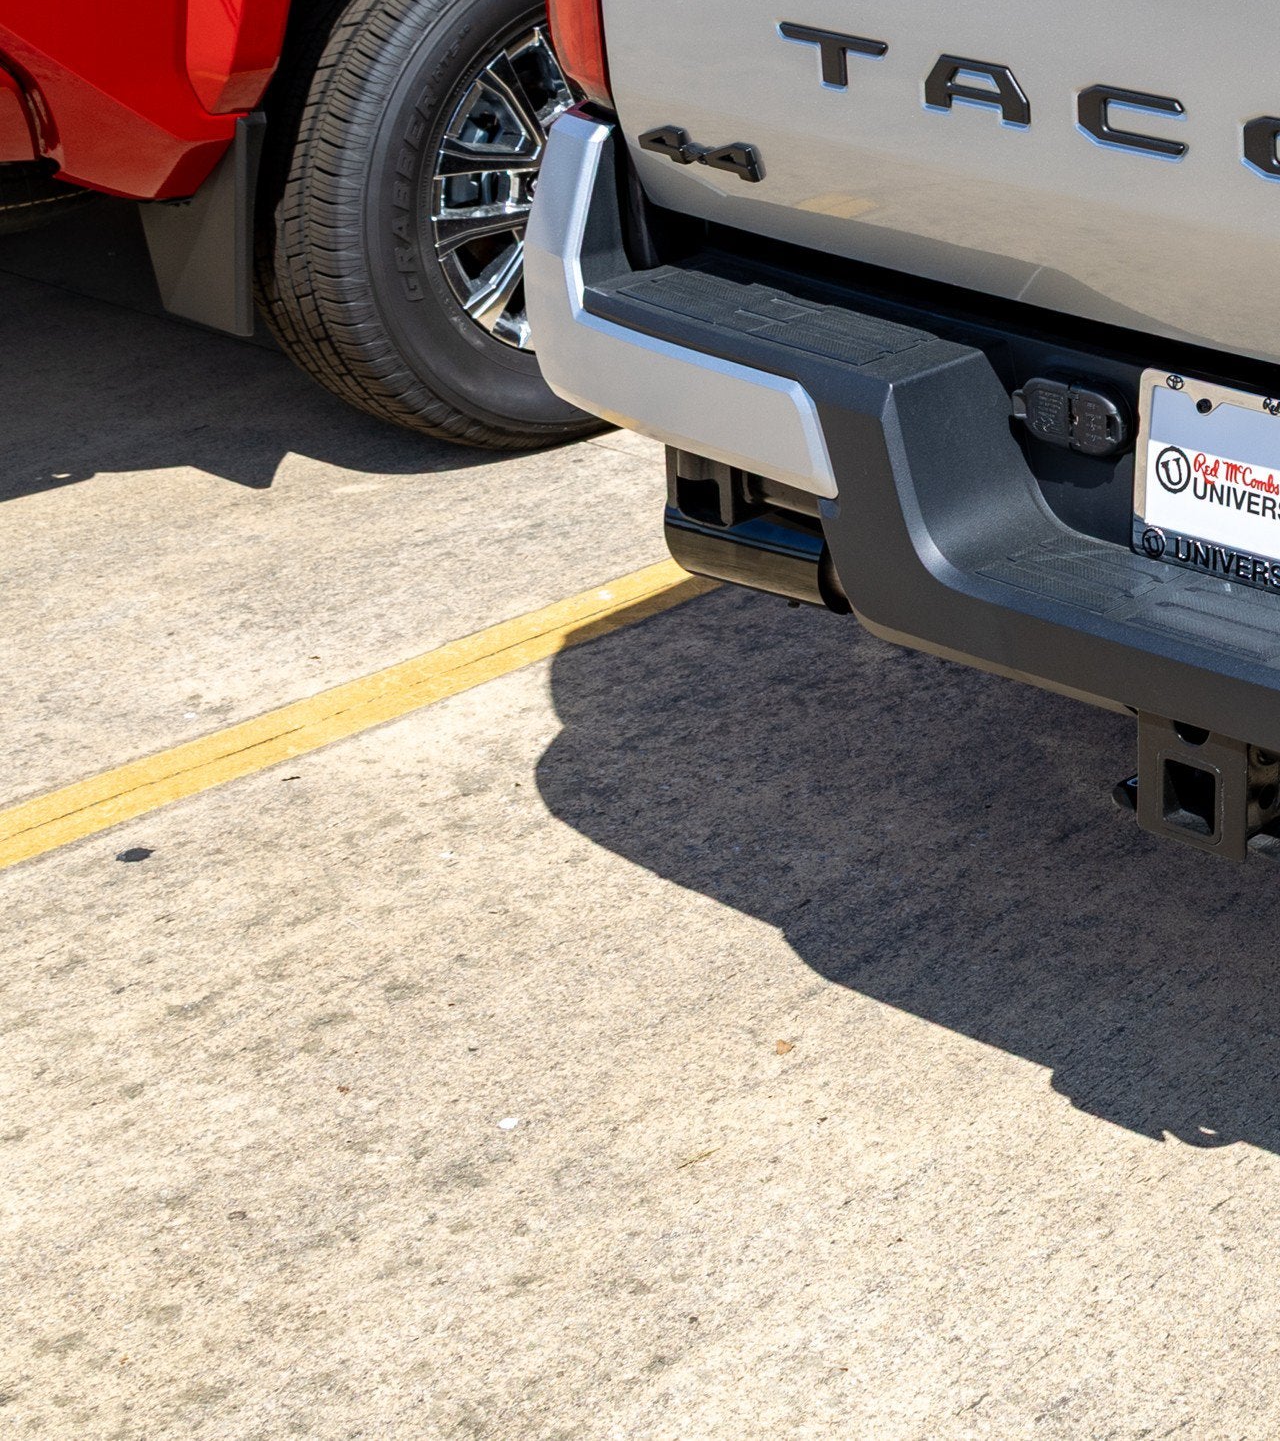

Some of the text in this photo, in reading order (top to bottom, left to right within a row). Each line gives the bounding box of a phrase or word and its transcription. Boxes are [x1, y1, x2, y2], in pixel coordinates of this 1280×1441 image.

[391, 84, 439, 302] GRABBER
[1262, 397, 1280, 416] Red
[1193, 453, 1280, 496] Red McCombs
